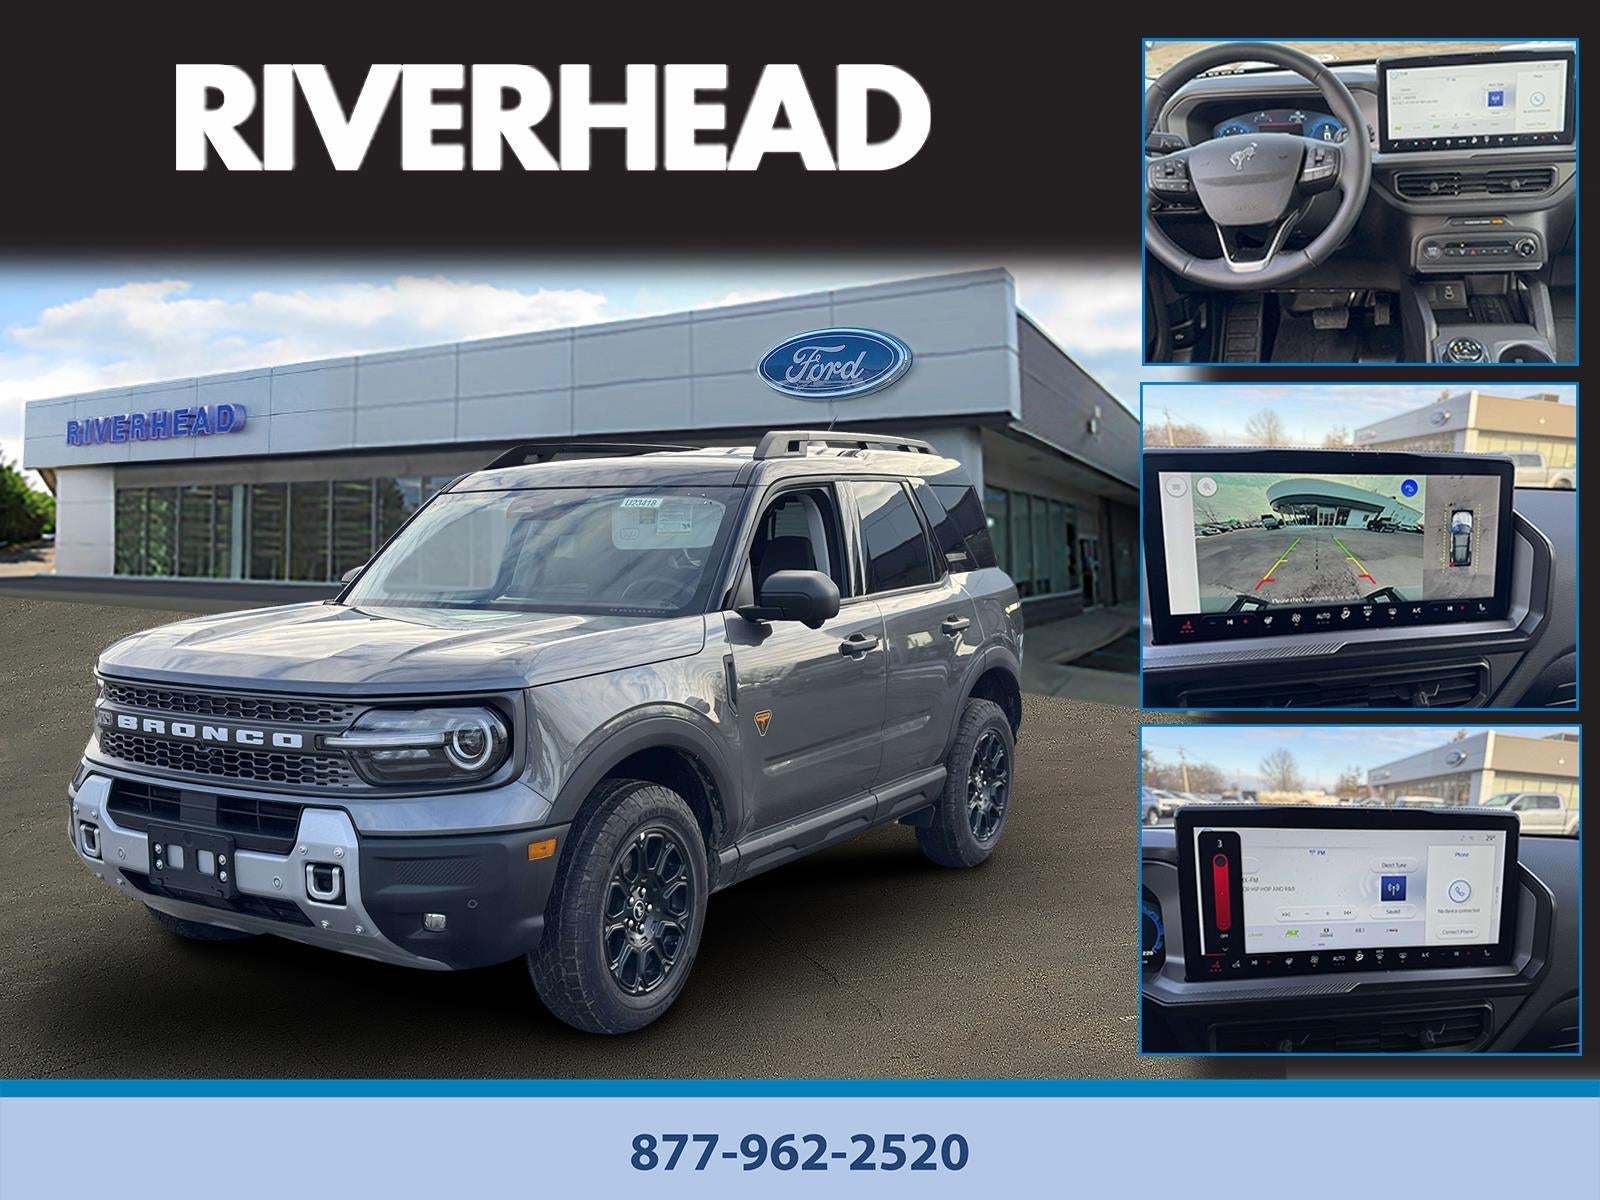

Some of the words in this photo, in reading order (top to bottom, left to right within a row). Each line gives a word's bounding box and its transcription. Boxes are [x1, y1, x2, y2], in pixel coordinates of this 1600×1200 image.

[785, 344, 867, 384] Ford
[66, 403, 247, 447] RIVERHEAD
[1315, 612, 1331, 620] AUTO
[117, 714, 303, 748] BRONCO
